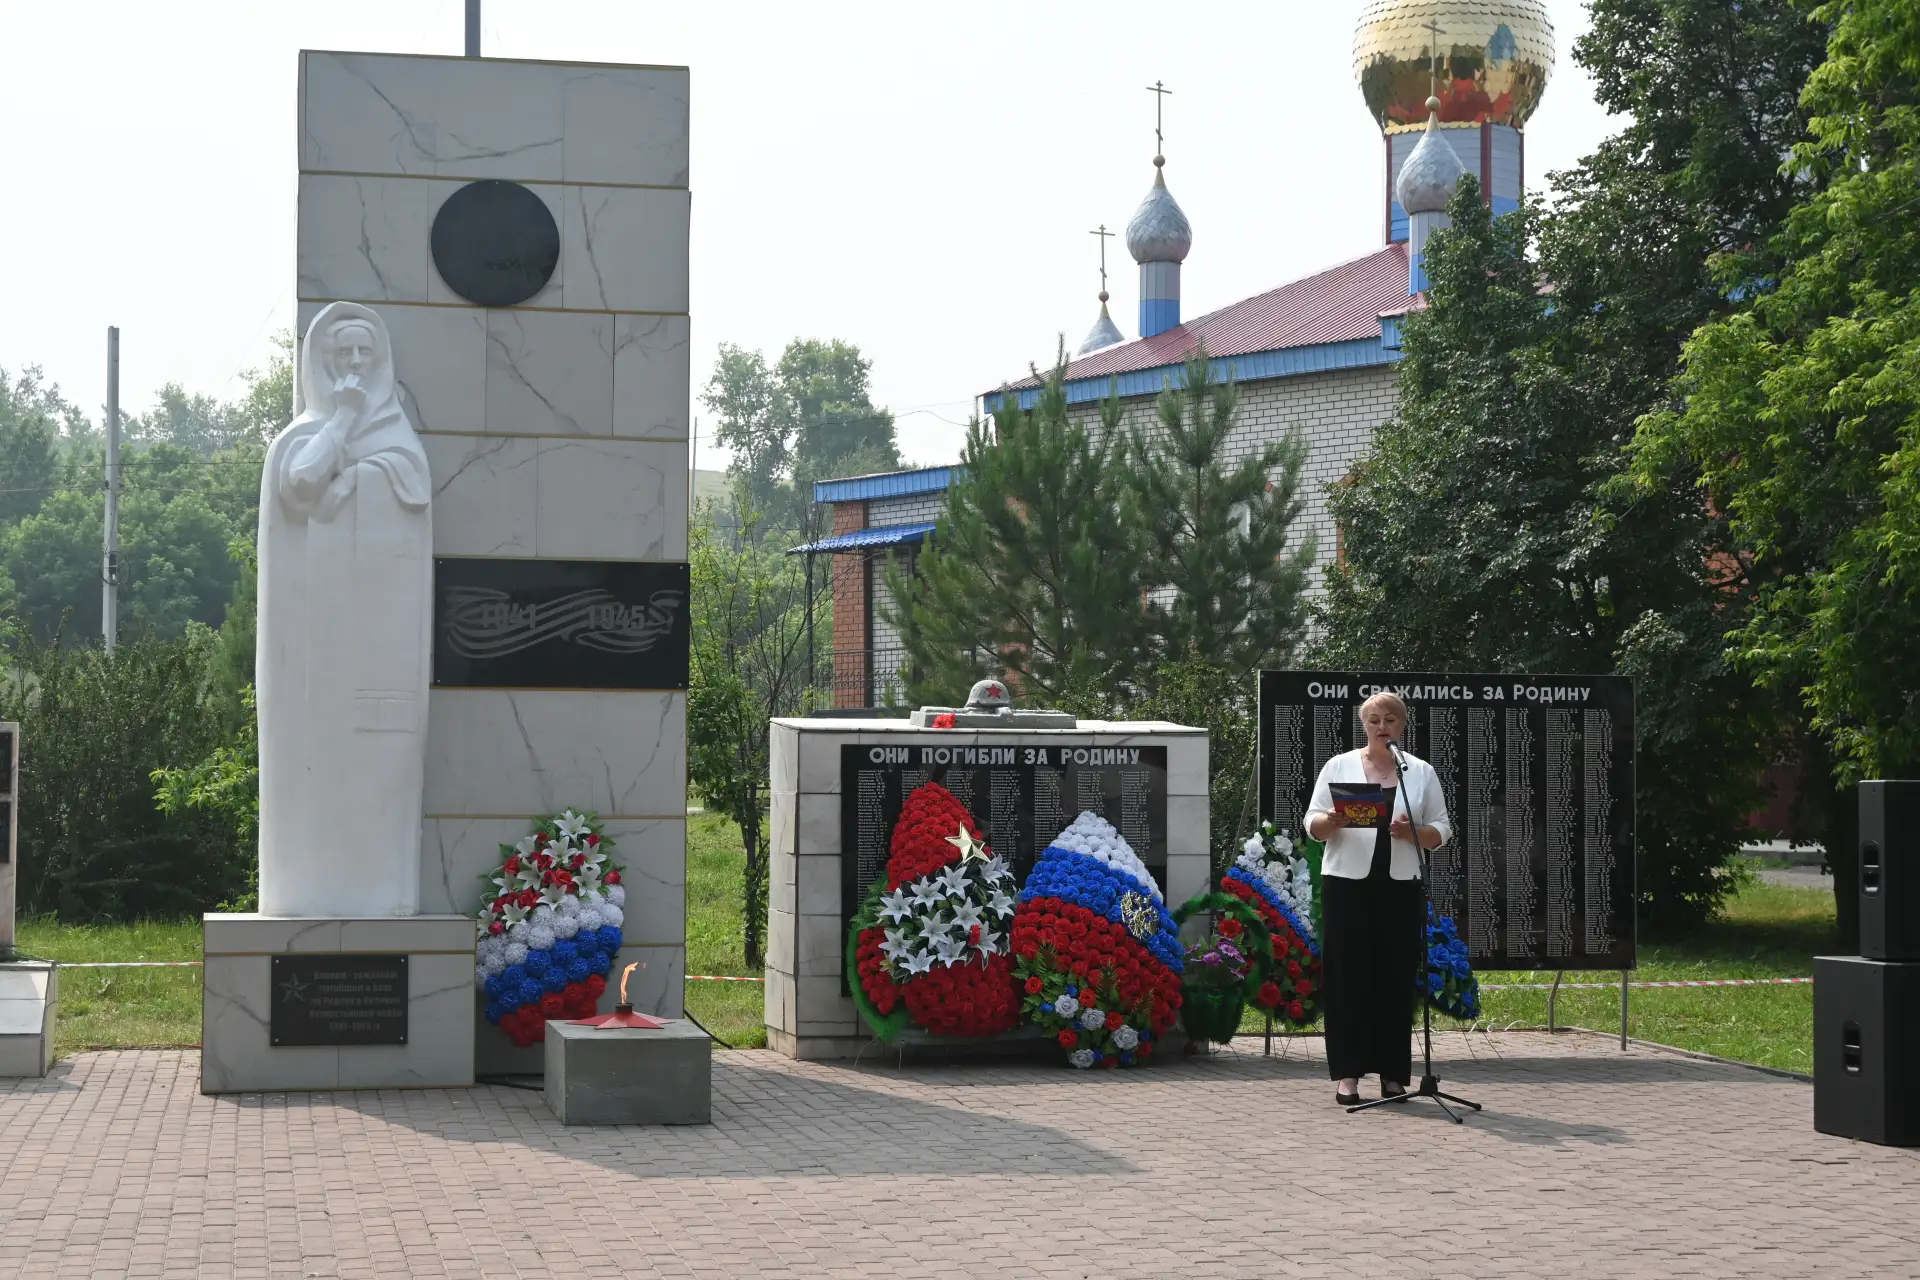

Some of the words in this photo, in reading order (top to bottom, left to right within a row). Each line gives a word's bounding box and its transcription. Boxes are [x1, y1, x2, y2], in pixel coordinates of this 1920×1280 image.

[587, 603, 645, 630] 1945
[869, 747, 909, 764] ОНИ
[921, 747, 1015, 765] ПОГИБЛИ
[1024, 748, 1049, 765] ЗА
[1061, 748, 1141, 766] РОДИНУ
